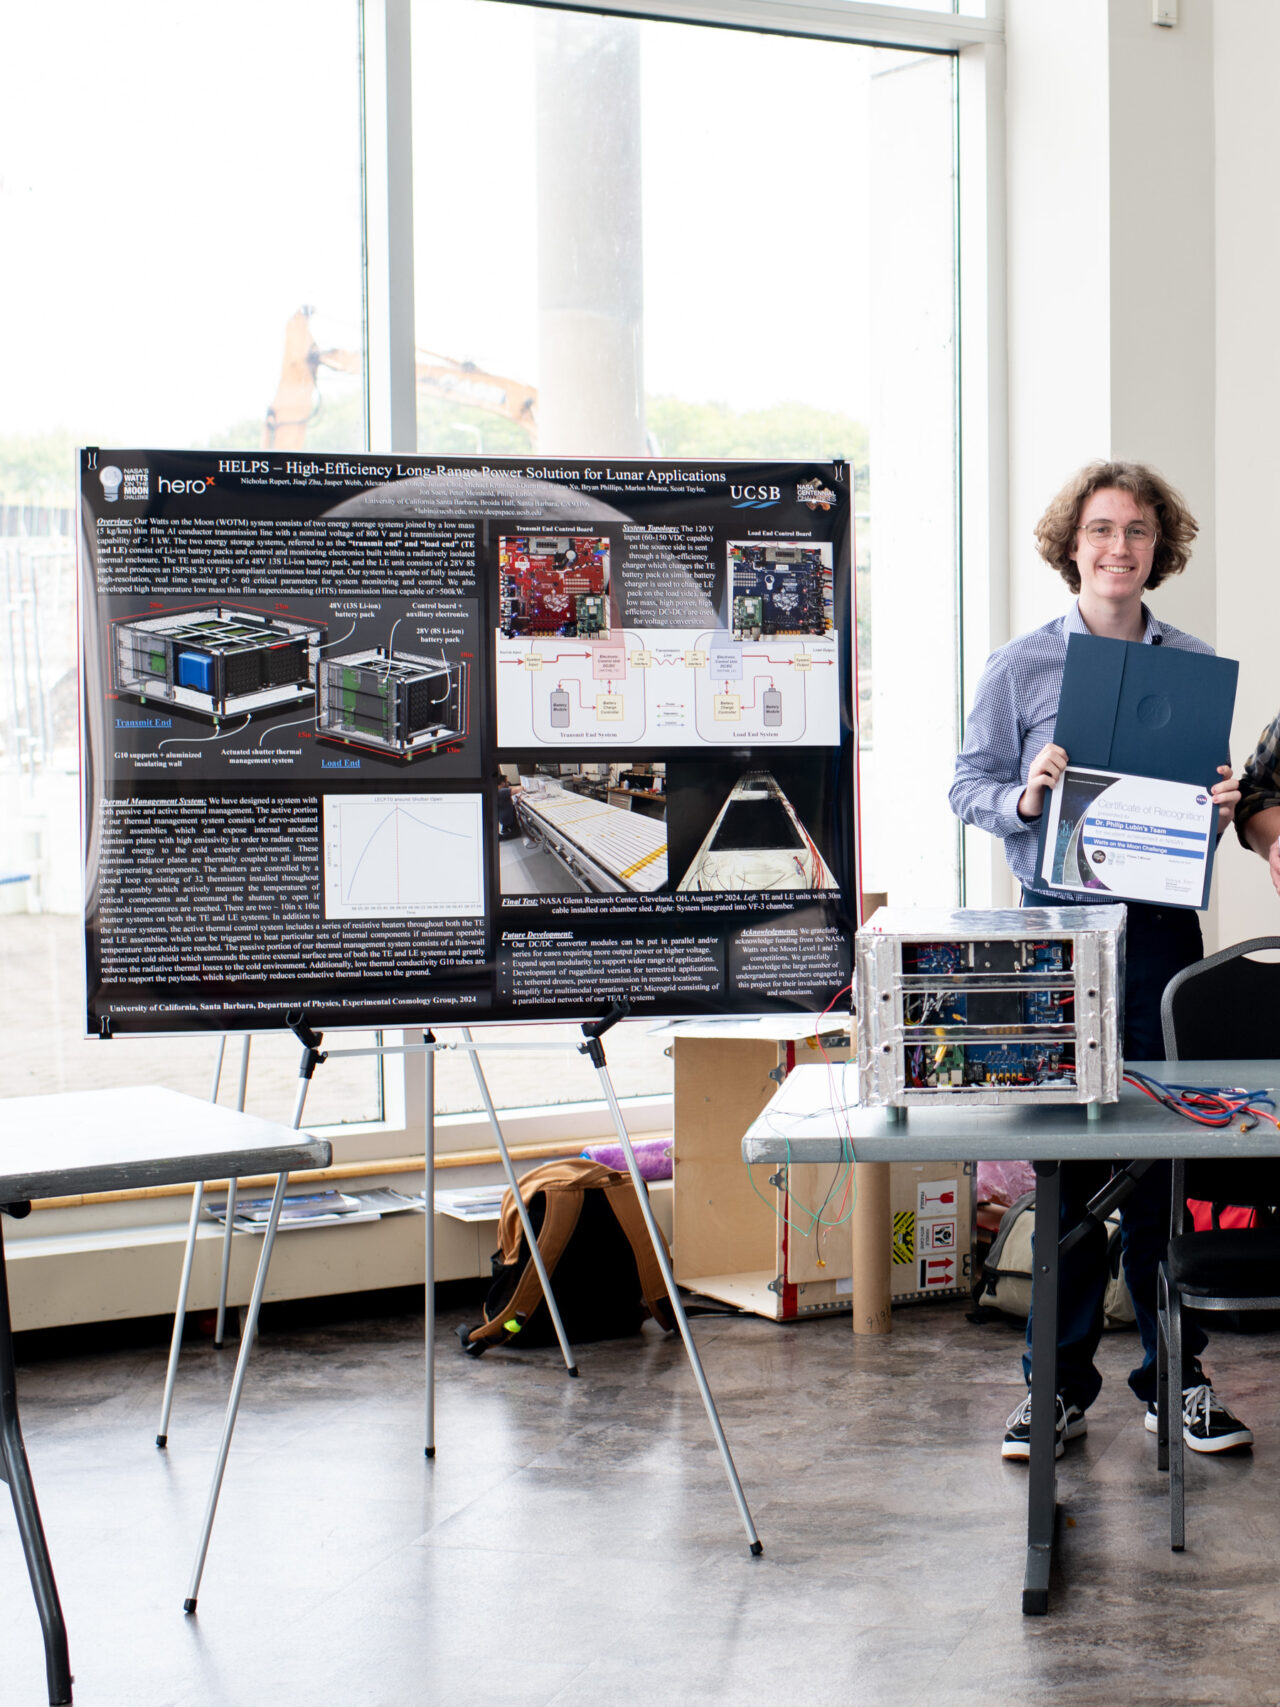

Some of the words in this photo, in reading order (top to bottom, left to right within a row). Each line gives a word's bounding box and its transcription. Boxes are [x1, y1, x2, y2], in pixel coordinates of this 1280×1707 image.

[218, 460, 269, 473] HELPS
[286, 462, 392, 478] High-Efficiency
[396, 464, 477, 480] Long-Range
[481, 465, 522, 477] Power
[526, 466, 579, 478] Solution
[584, 467, 602, 479] for
[606, 467, 644, 479] Lunar
[646, 468, 726, 484] Applications
[124, 486, 148, 495] MOON
[730, 486, 780, 500] UCSB
[622, 525, 645, 534] System
[624, 535, 640, 543] input
[129, 751, 158, 760] supports
[134, 760, 166, 768] insulating
[1098, 799, 1140, 814] Certificate
[1142, 805, 1152, 814] of
[1154, 806, 1205, 823] Recognition
[1106, 820, 1124, 830] Philip
[1125, 824, 1148, 832] Lubin's
[1127, 842, 1142, 850] Moon
[1142, 845, 1168, 854] Challenge
[528, 931, 573, 940] Development:
[110, 1003, 147, 1013] University
[158, 1002, 198, 1011] California,
[223, 1001, 255, 1010] Barbara,
[258, 1000, 300, 1010] Department
[312, 999, 340, 1008] Physics,
[342, 998, 390, 1008] Experimental
[392, 998, 431, 1006] Cosmology
[432, 997, 458, 1006] Group,
